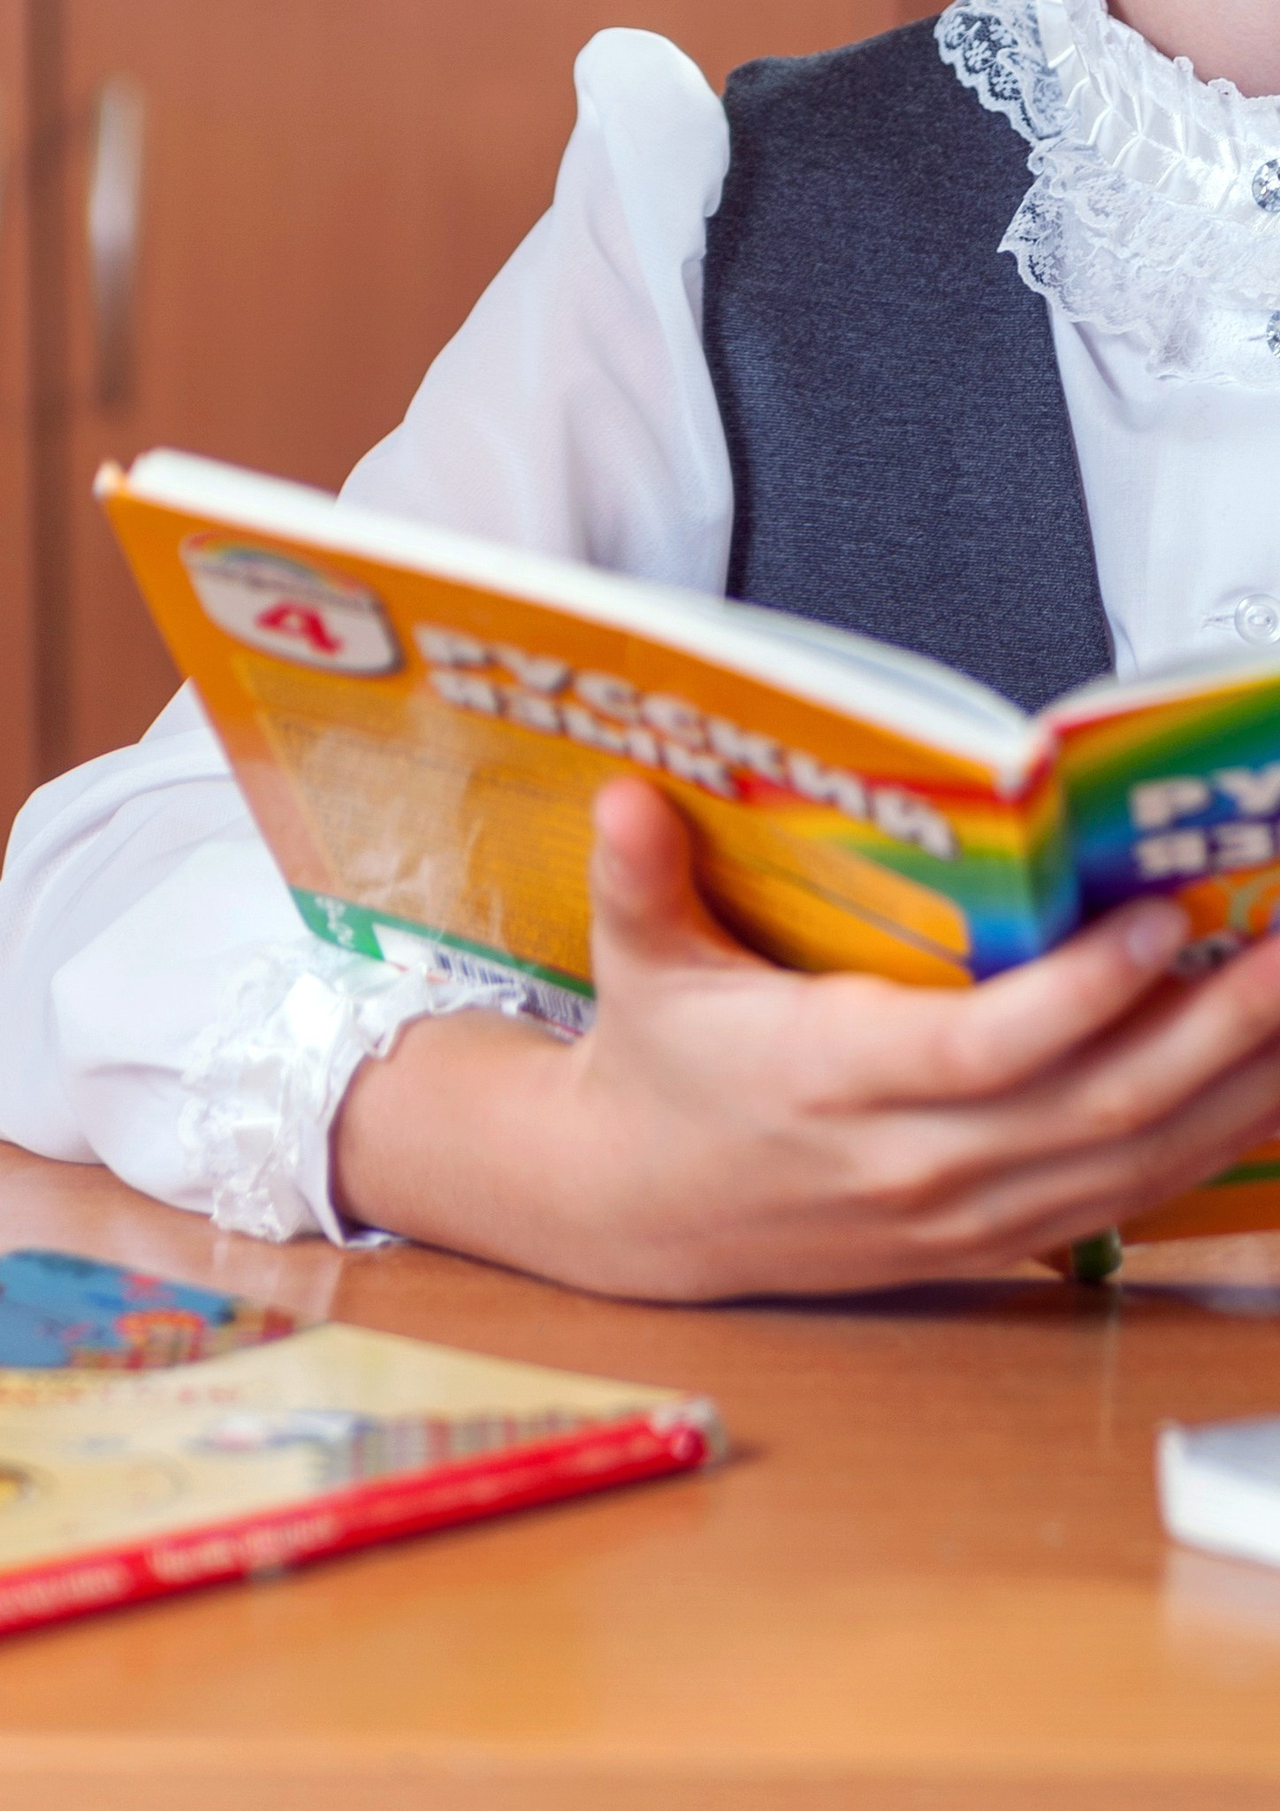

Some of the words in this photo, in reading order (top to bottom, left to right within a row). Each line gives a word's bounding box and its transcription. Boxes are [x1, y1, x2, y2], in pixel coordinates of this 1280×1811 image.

[255, 598, 343, 656] 4
[411, 623, 960, 862] РУССКИЙ
[428, 668, 739, 800] ЯЗЫК
